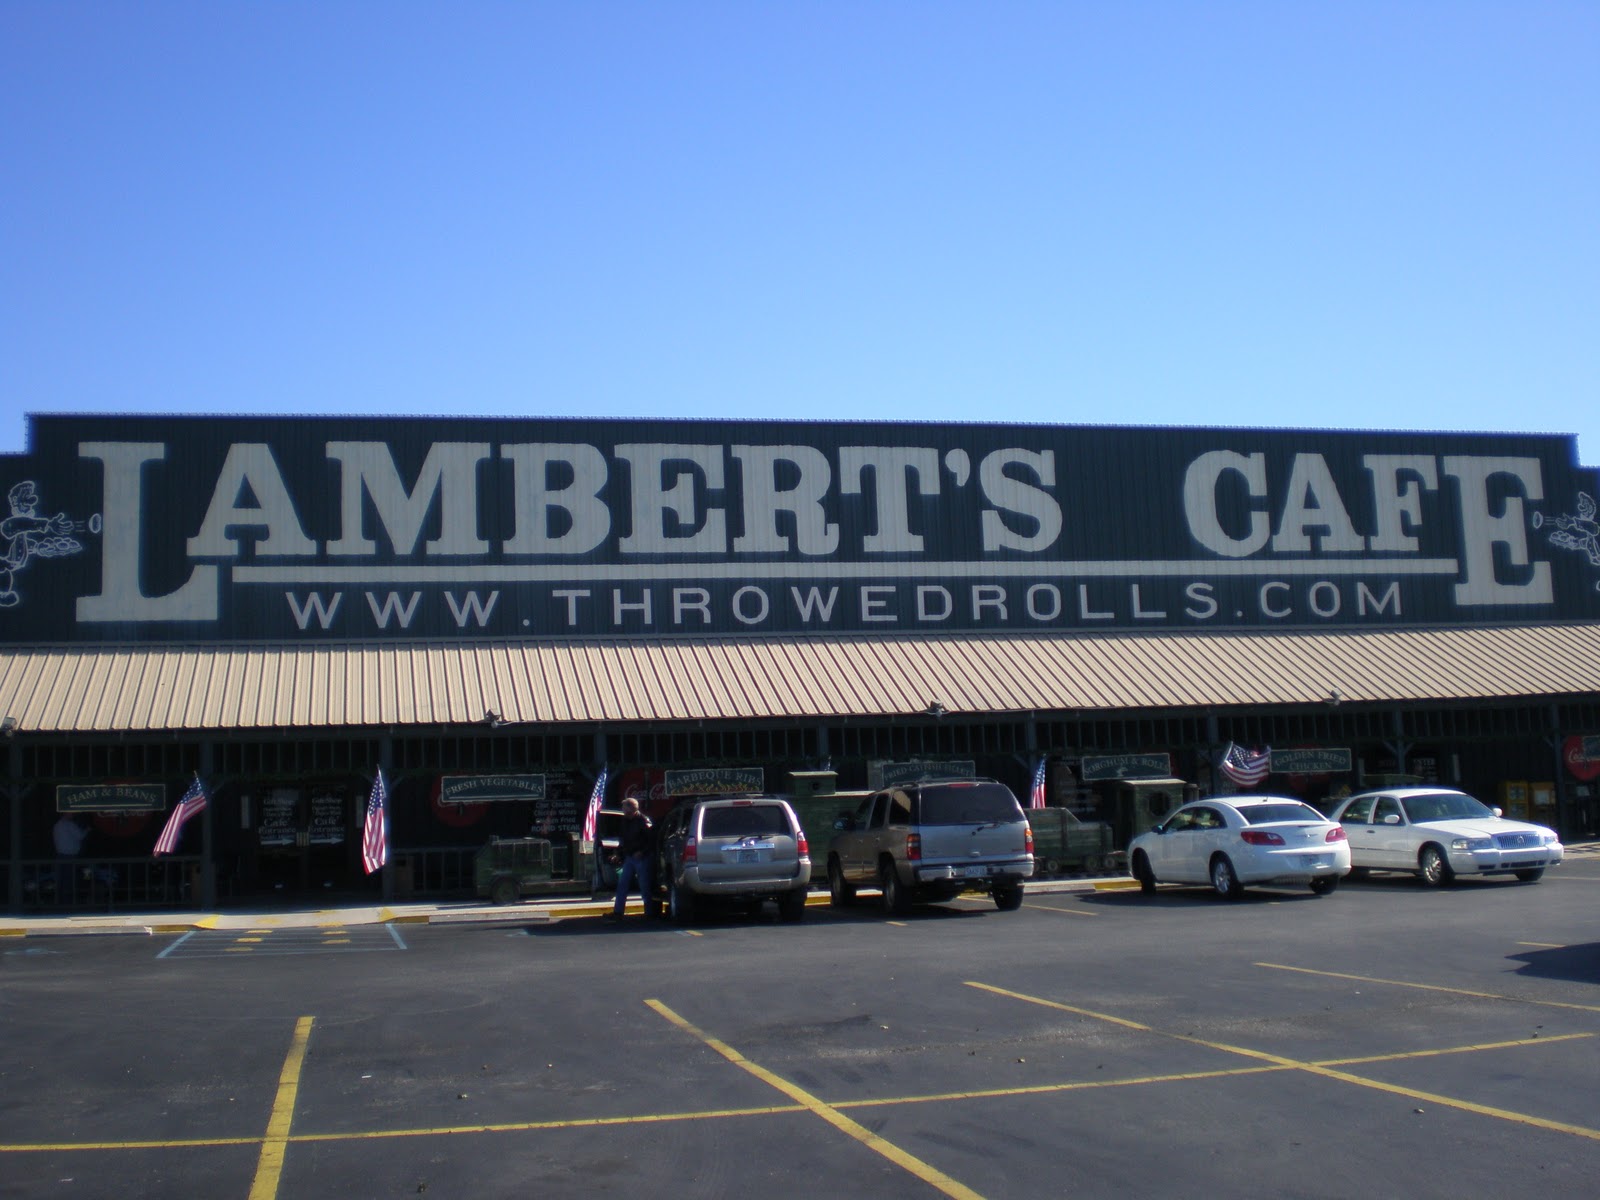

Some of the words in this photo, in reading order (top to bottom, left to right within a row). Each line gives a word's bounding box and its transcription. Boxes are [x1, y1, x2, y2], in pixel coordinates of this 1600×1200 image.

[75, 440, 1063, 622] LAMBERT'S
[1183, 449, 1555, 606] CAFE
[1084, 757, 1128, 774] SORGHUM
[1141, 757, 1170, 771] ROLLS
[1275, 750, 1314, 766] GOLDEN
[1318, 750, 1347, 764] FRIED
[1289, 762, 1332, 771] CHICKEN
[668, 768, 732, 789] BARBEQUE
[735, 770, 762, 785] RIBS
[884, 767, 907, 781] FRIED
[445, 780, 478, 796] FRESH
[480, 777, 543, 793] VEGETABLES
[66, 788, 97, 804] HAM
[101, 787, 112, 797] &
[115, 787, 158, 804] BEANS
